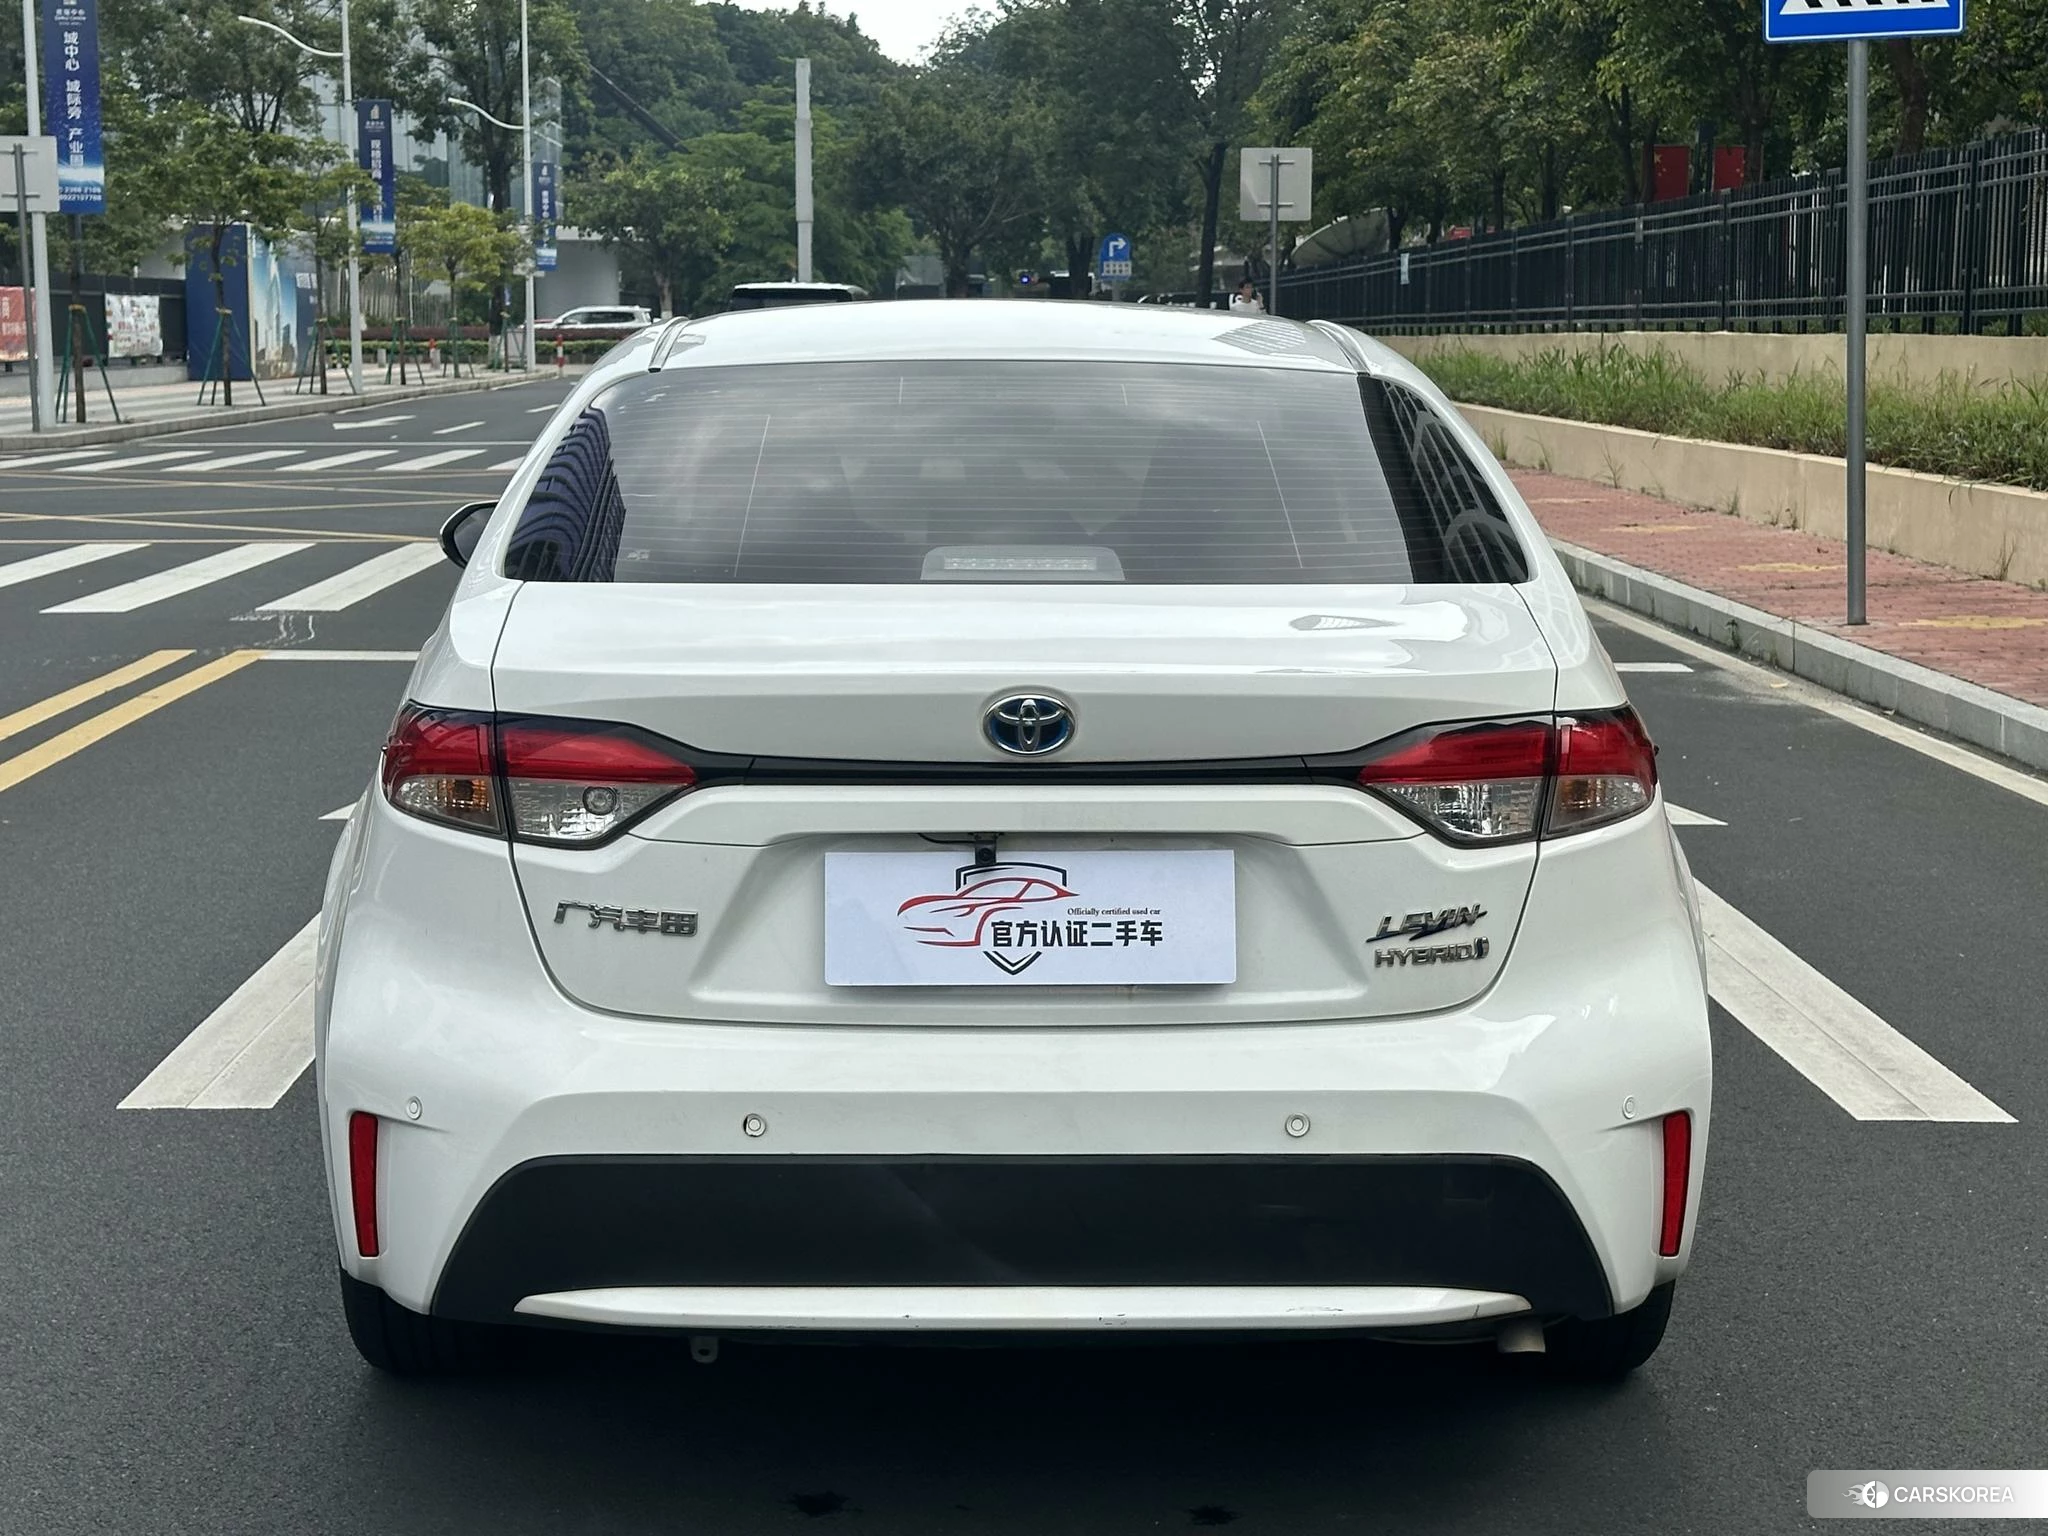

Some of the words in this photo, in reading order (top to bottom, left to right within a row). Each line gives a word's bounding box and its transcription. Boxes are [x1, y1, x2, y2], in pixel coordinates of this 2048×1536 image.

[63, 31, 80, 72] 城中心
[1067, 907, 1100, 916] Officially
[1101, 907, 1130, 915] certified
[1132, 907, 1148, 915] used
[1374, 903, 1482, 938] LEVIN
[991, 920, 1163, 948] 官方认证二手车
[1375, 943, 1473, 968] HYBRID
